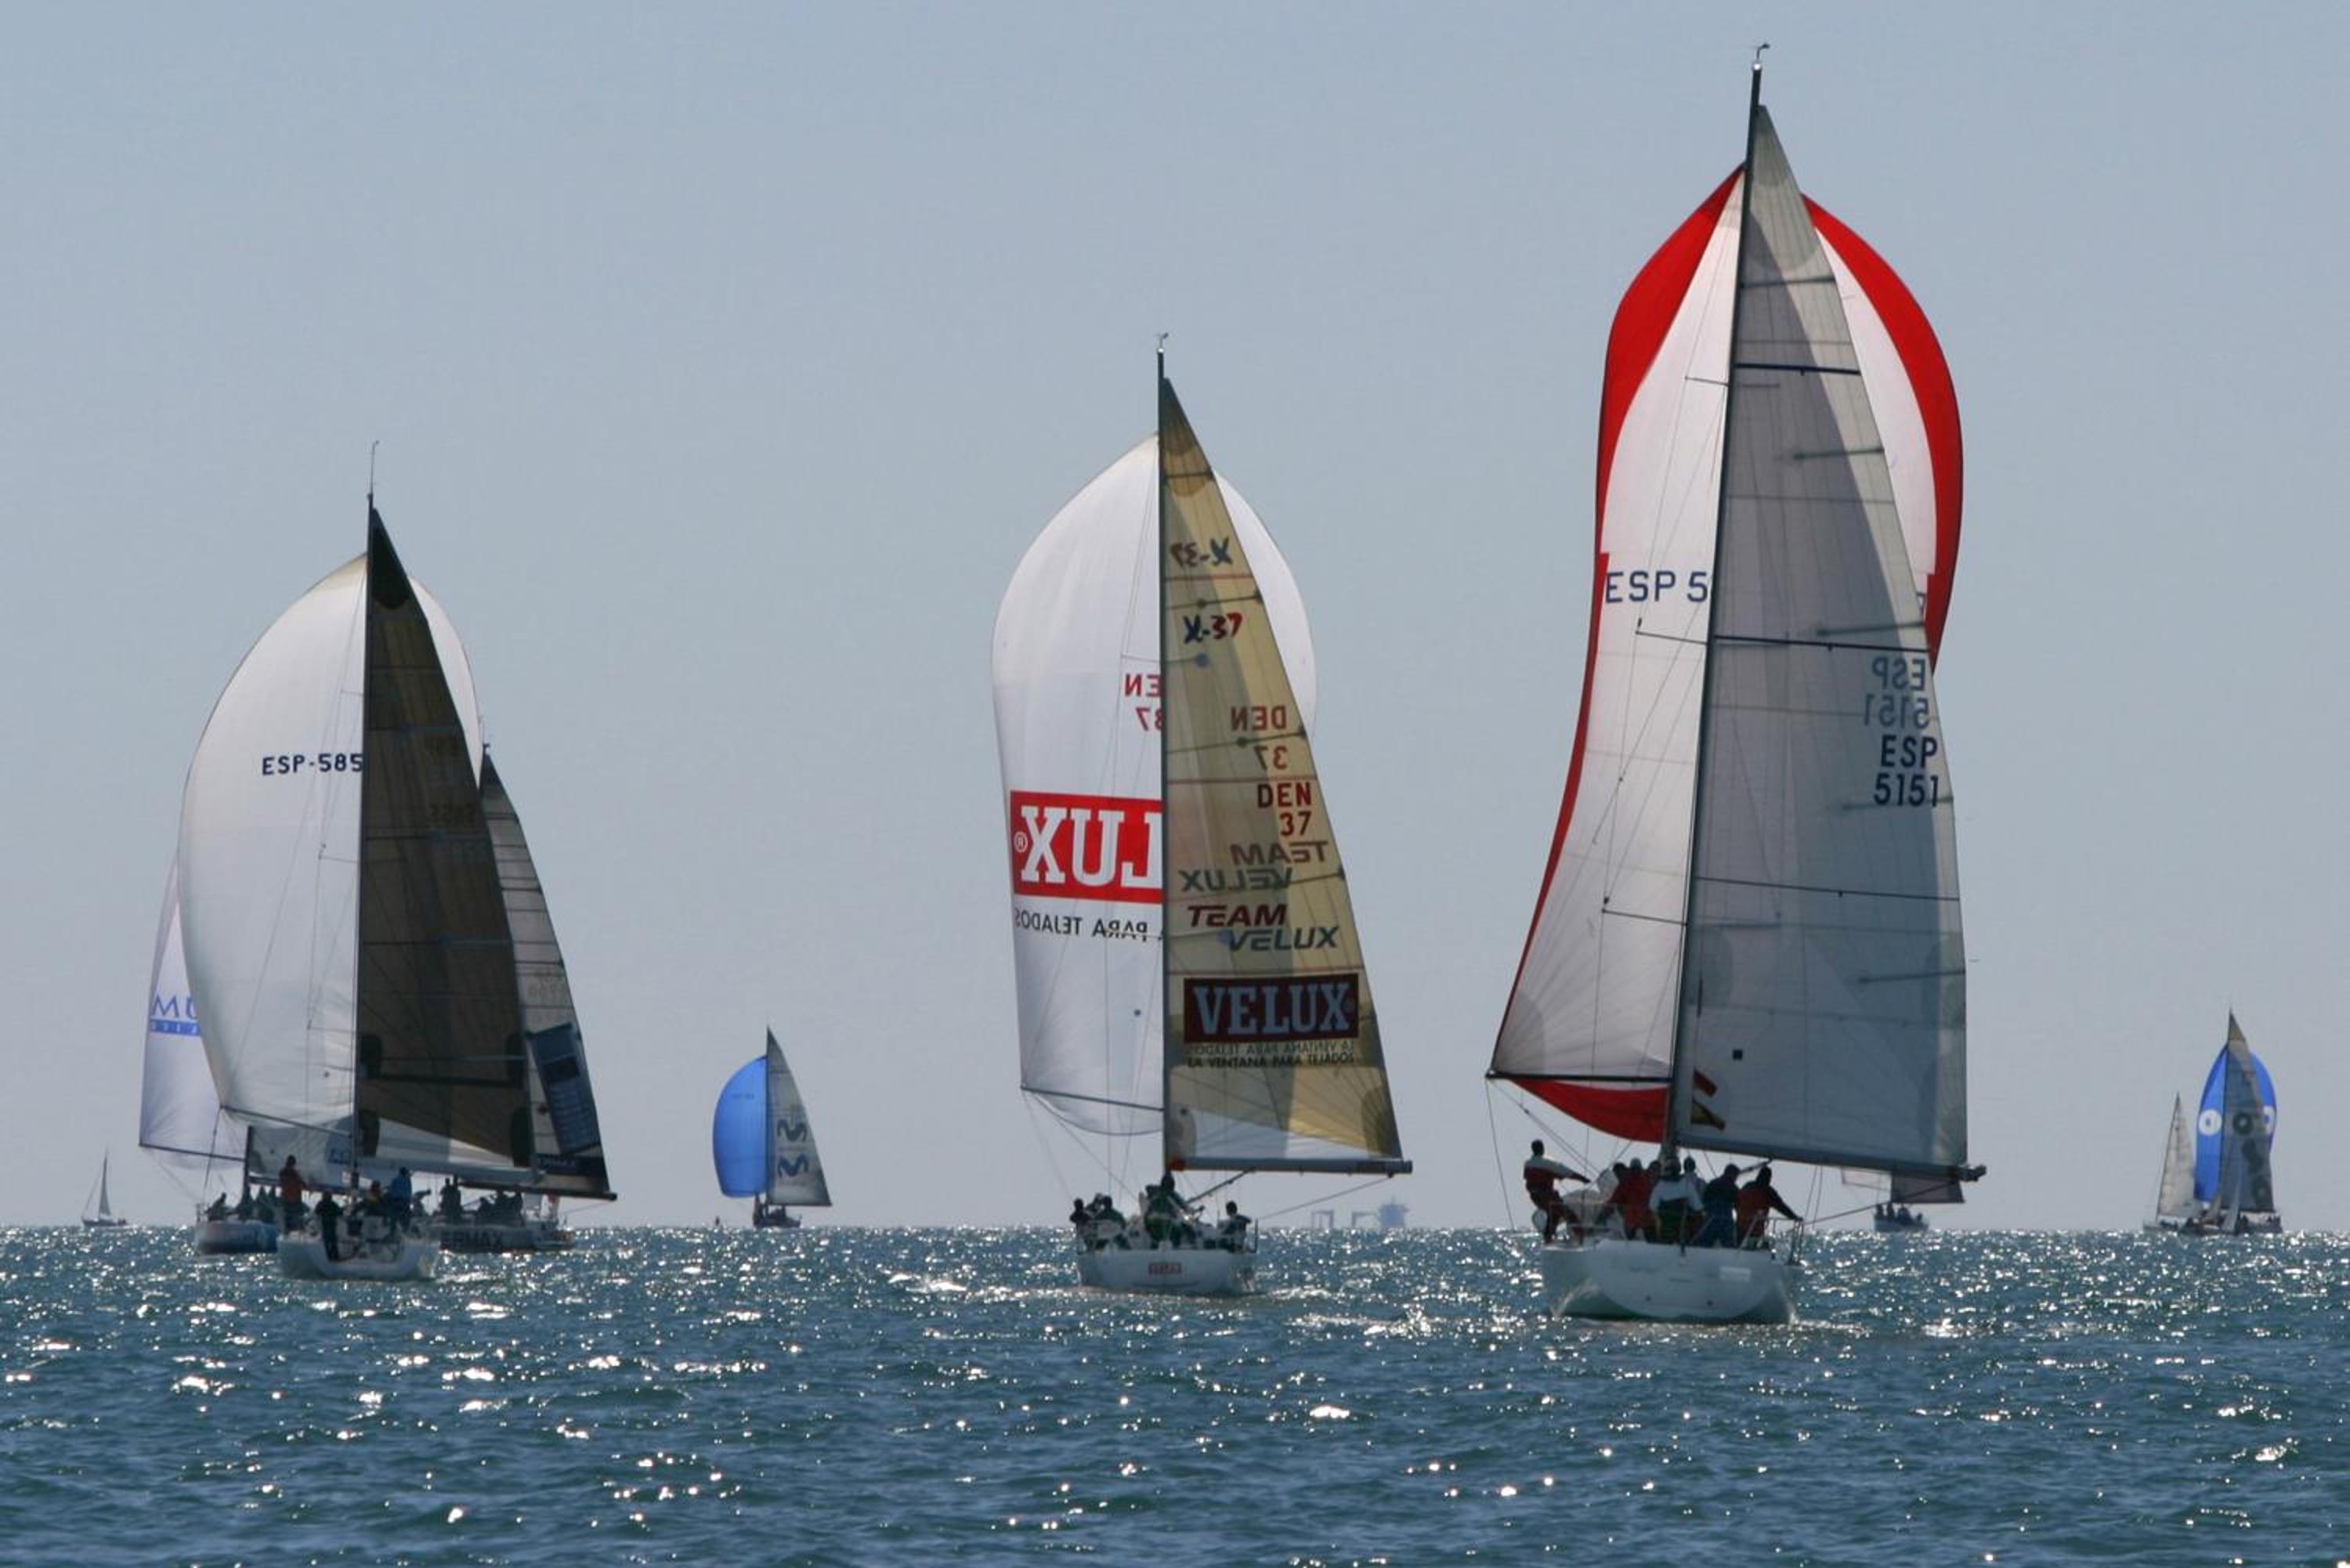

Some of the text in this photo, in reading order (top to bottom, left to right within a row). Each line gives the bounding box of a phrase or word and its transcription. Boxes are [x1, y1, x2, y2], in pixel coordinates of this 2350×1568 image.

[1606, 570, 1708, 603] ESP 5
[1183, 612, 1244, 644] X-37
[262, 753, 363, 776] ESP-585
[1881, 734, 1938, 770] ESP
[1256, 782, 1312, 809] DEN
[1873, 771, 1940, 807] 5151
[1280, 811, 1312, 836] 37
[1188, 902, 1288, 928] TEAM
[1227, 924, 1340, 952] VELUX
[1194, 984, 1350, 1035] VELUX
